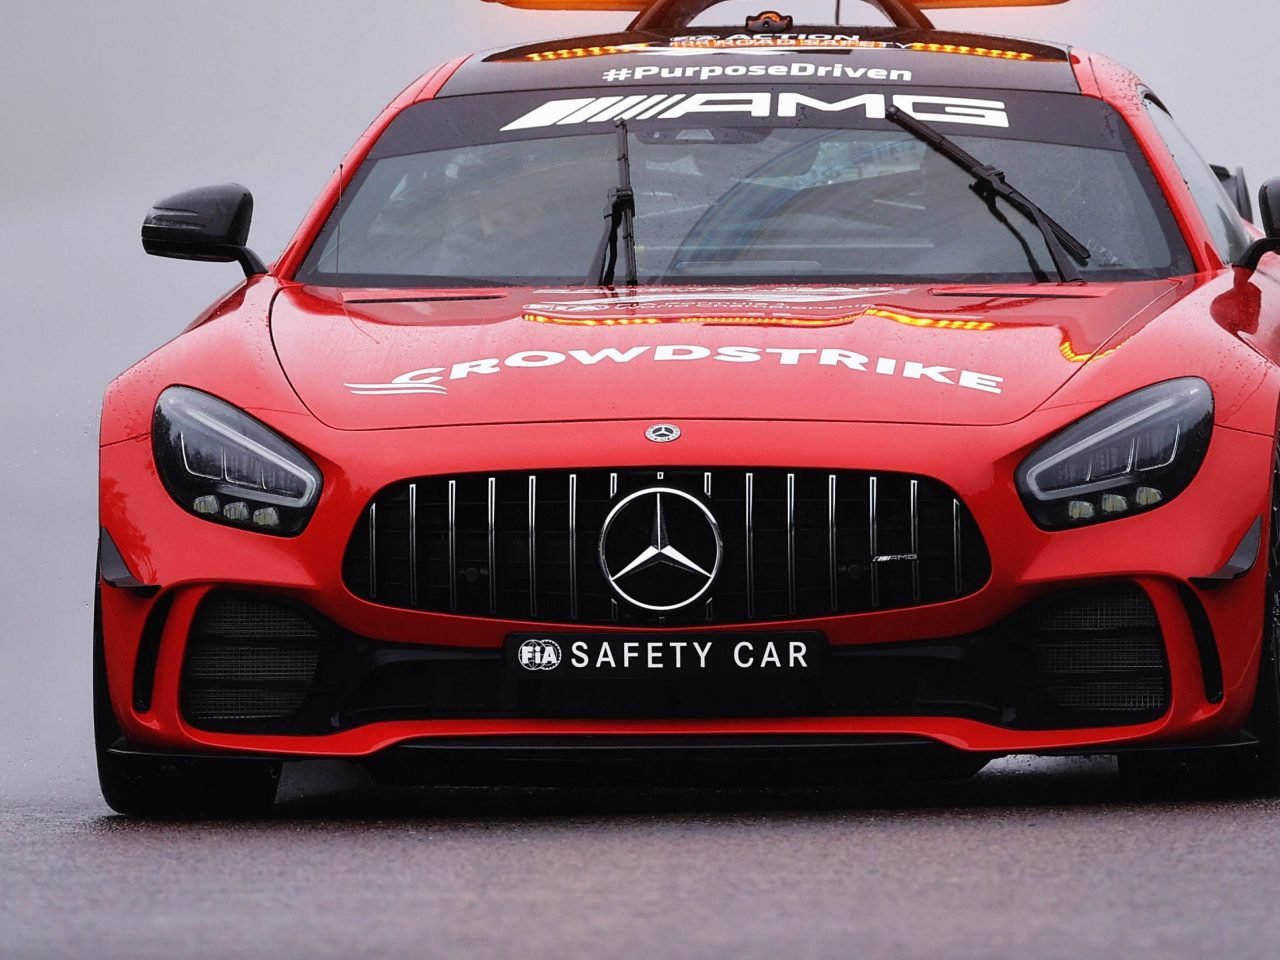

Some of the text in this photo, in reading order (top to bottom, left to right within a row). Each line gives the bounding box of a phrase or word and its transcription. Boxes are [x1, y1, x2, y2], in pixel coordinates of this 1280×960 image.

[725, 33, 860, 42] ACTION
[602, 62, 912, 81] #PurposeDriven
[655, 92, 1009, 128] AMG
[390, 344, 1004, 395] CROWDSTRIKE
[570, 641, 713, 668] SAFETY
[733, 641, 808, 668] CAR
